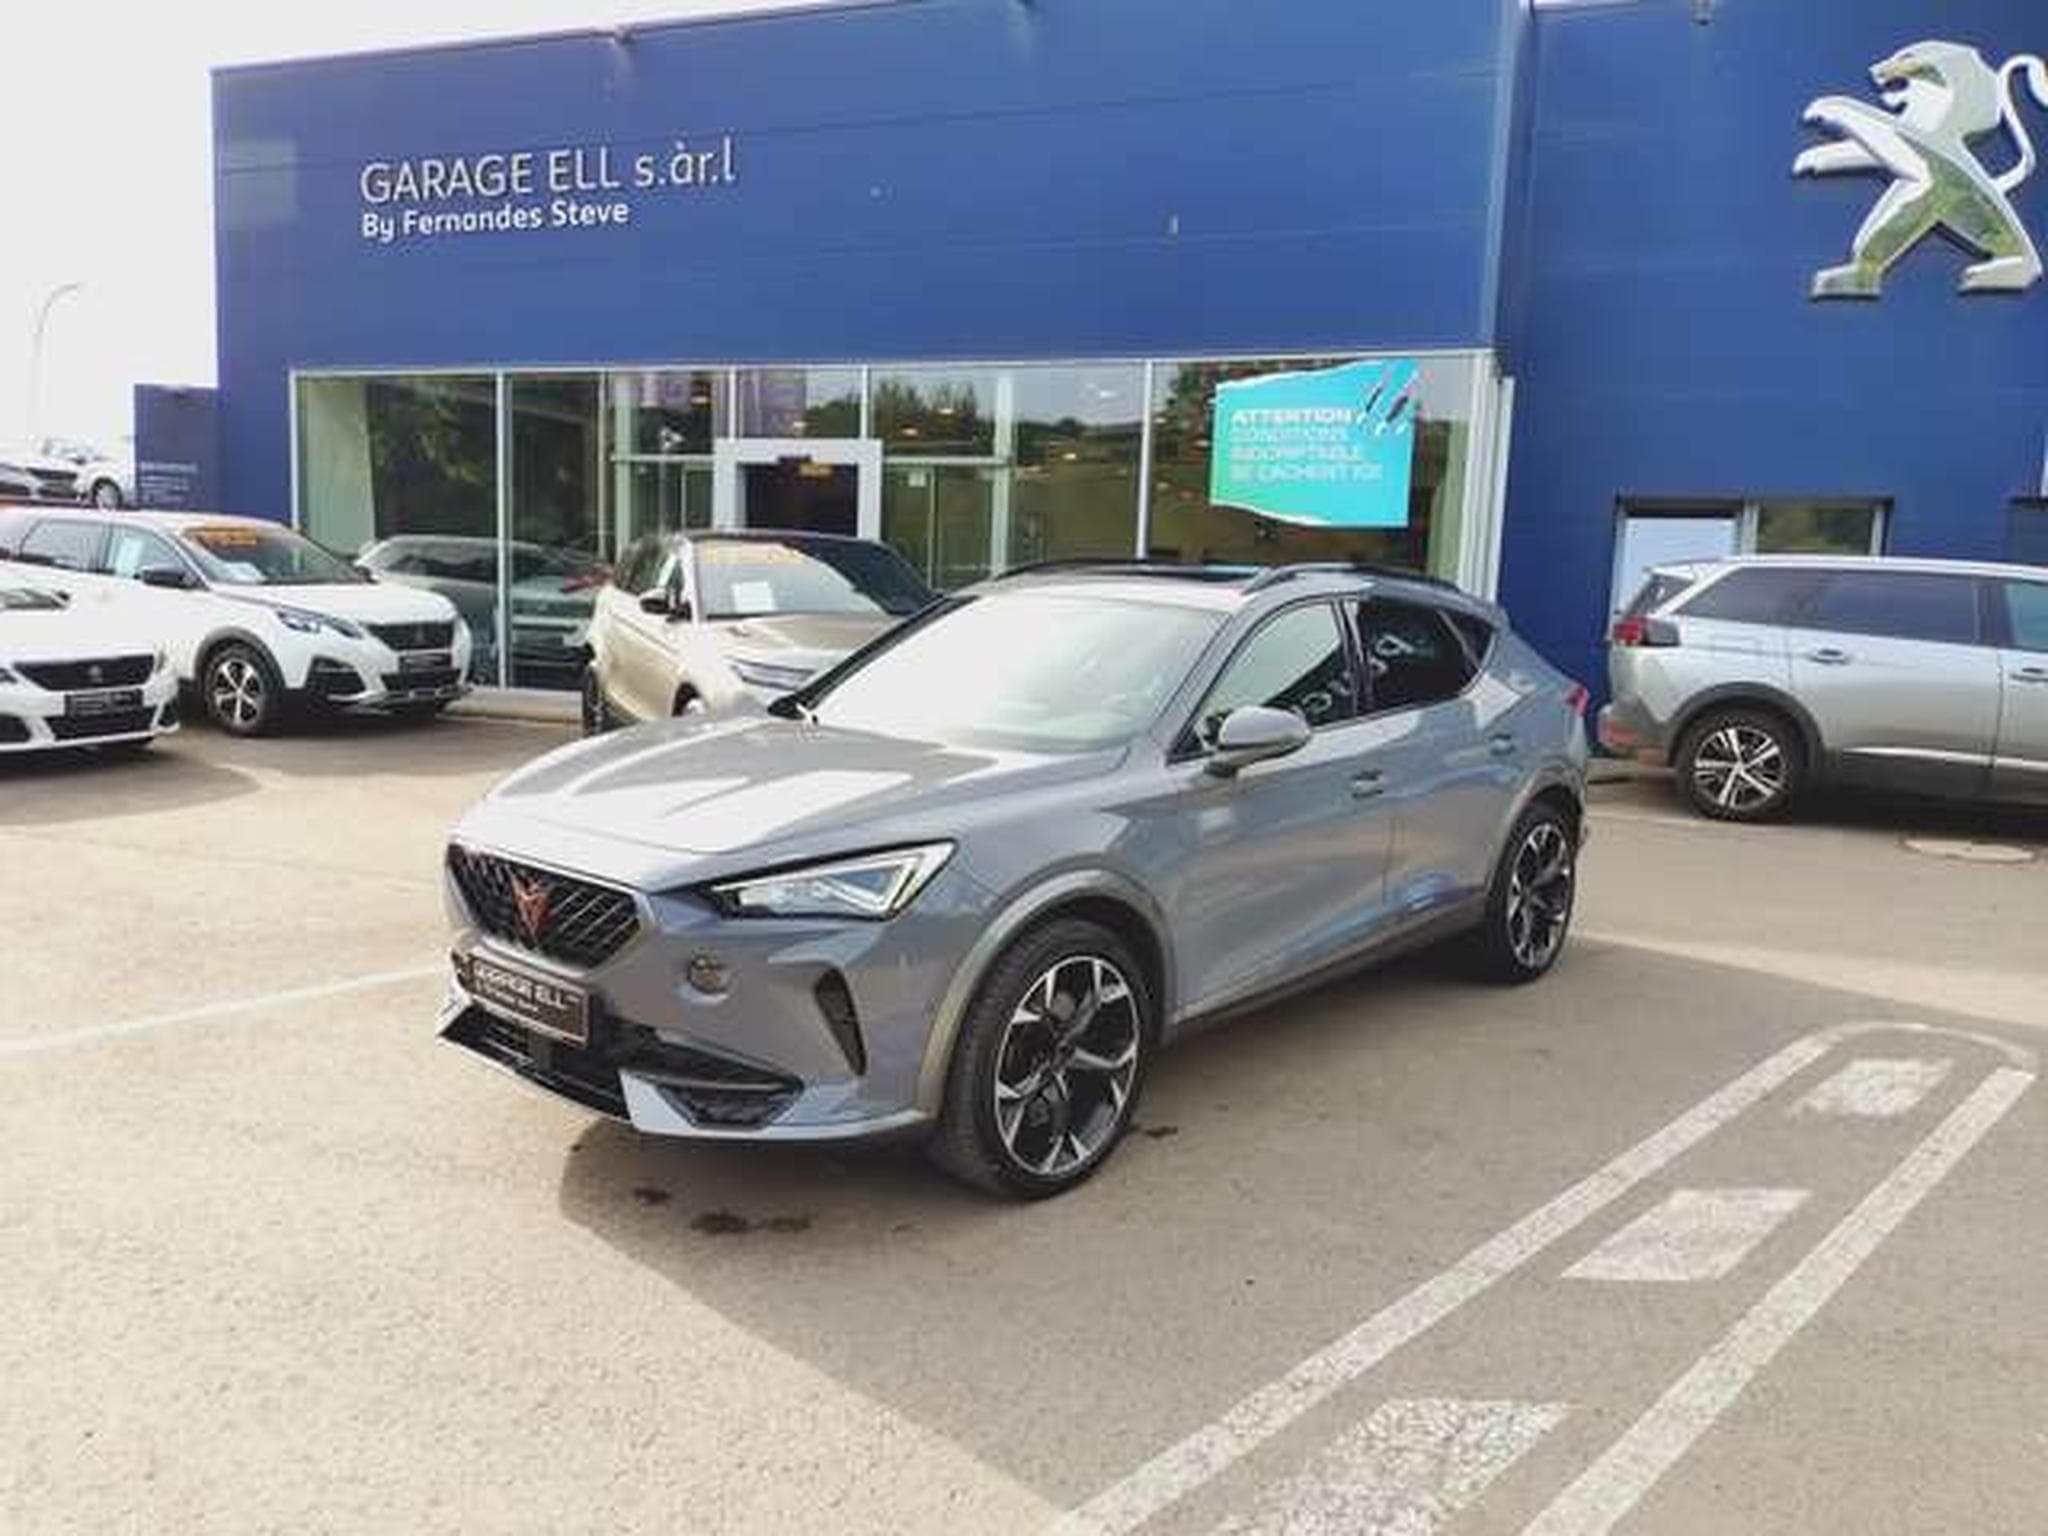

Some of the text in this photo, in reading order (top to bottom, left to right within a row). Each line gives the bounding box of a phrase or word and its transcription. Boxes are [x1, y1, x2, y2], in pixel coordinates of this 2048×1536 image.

[361, 153, 532, 203] GARAGE
[548, 147, 619, 190] ELL
[362, 199, 629, 243] By Fernandes Steve
[1231, 408, 1352, 425] ATTENTION
